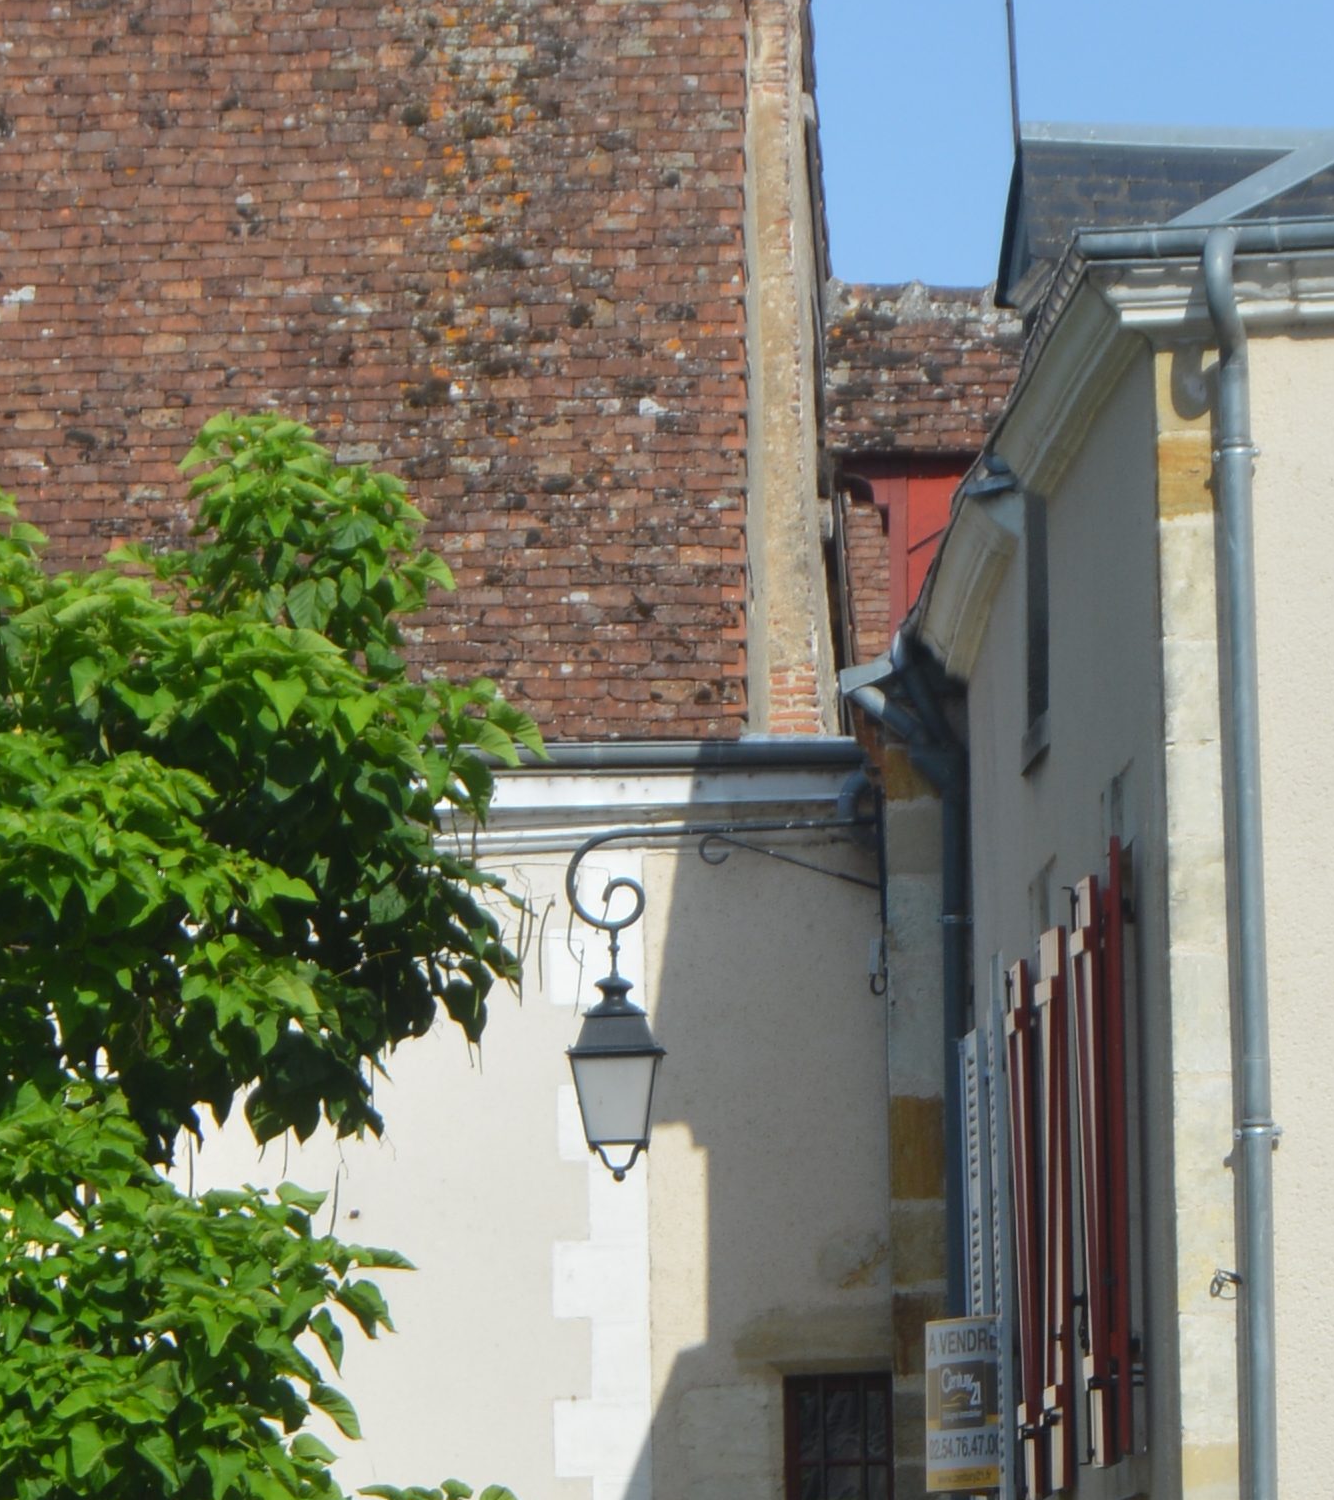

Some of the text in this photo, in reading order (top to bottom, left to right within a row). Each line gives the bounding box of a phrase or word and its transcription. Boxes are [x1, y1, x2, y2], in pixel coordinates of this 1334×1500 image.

[927, 1327, 998, 1357] A VENDRE
[941, 1368, 981, 1405] Century 21
